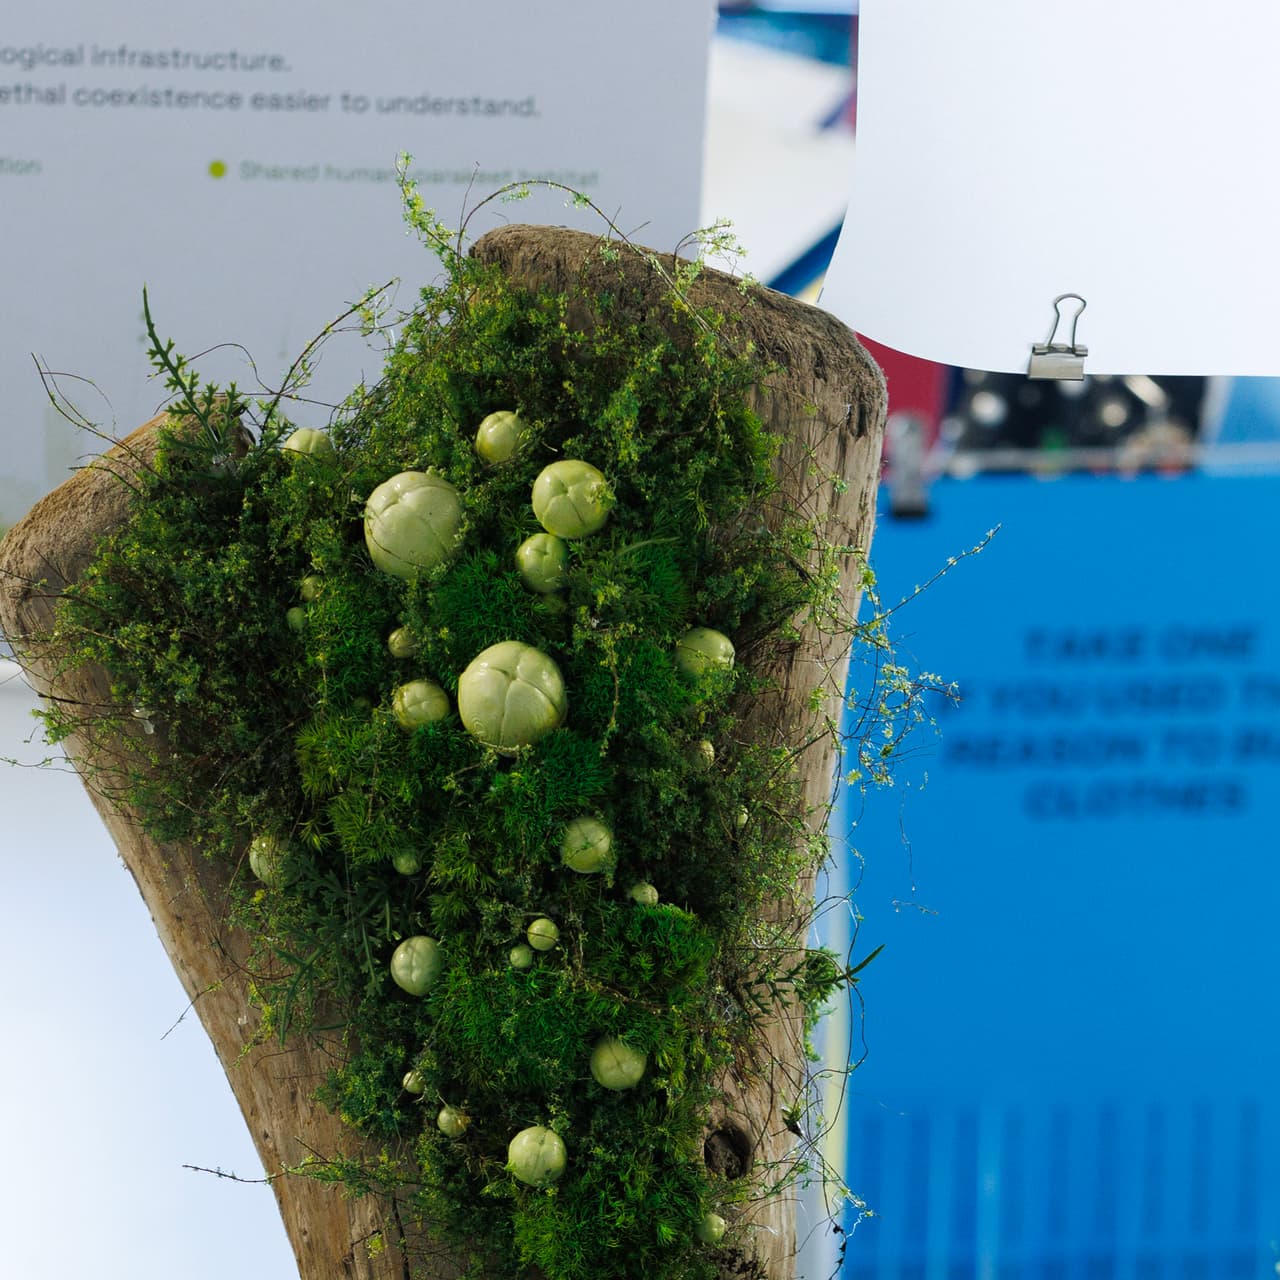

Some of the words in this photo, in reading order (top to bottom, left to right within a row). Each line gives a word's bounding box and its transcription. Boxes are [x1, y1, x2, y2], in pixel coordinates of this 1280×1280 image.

[90, 42, 291, 71] infrastructure.
[72, 83, 243, 109] coexistence
[249, 87, 330, 111] easier
[340, 91, 370, 112] to
[375, 90, 540, 116] understand.
[239, 160, 318, 181] Shared
[324, 163, 512, 188] humanparakeet
[1022, 624, 1146, 664] TAKE
[1156, 620, 1256, 663] ONE
[989, 676, 1087, 719] YOU
[1093, 674, 1228, 716] USED
[943, 731, 1144, 772] REASON
[1158, 727, 1223, 764] TO
[1022, 777, 1247, 822] CLOTHES
